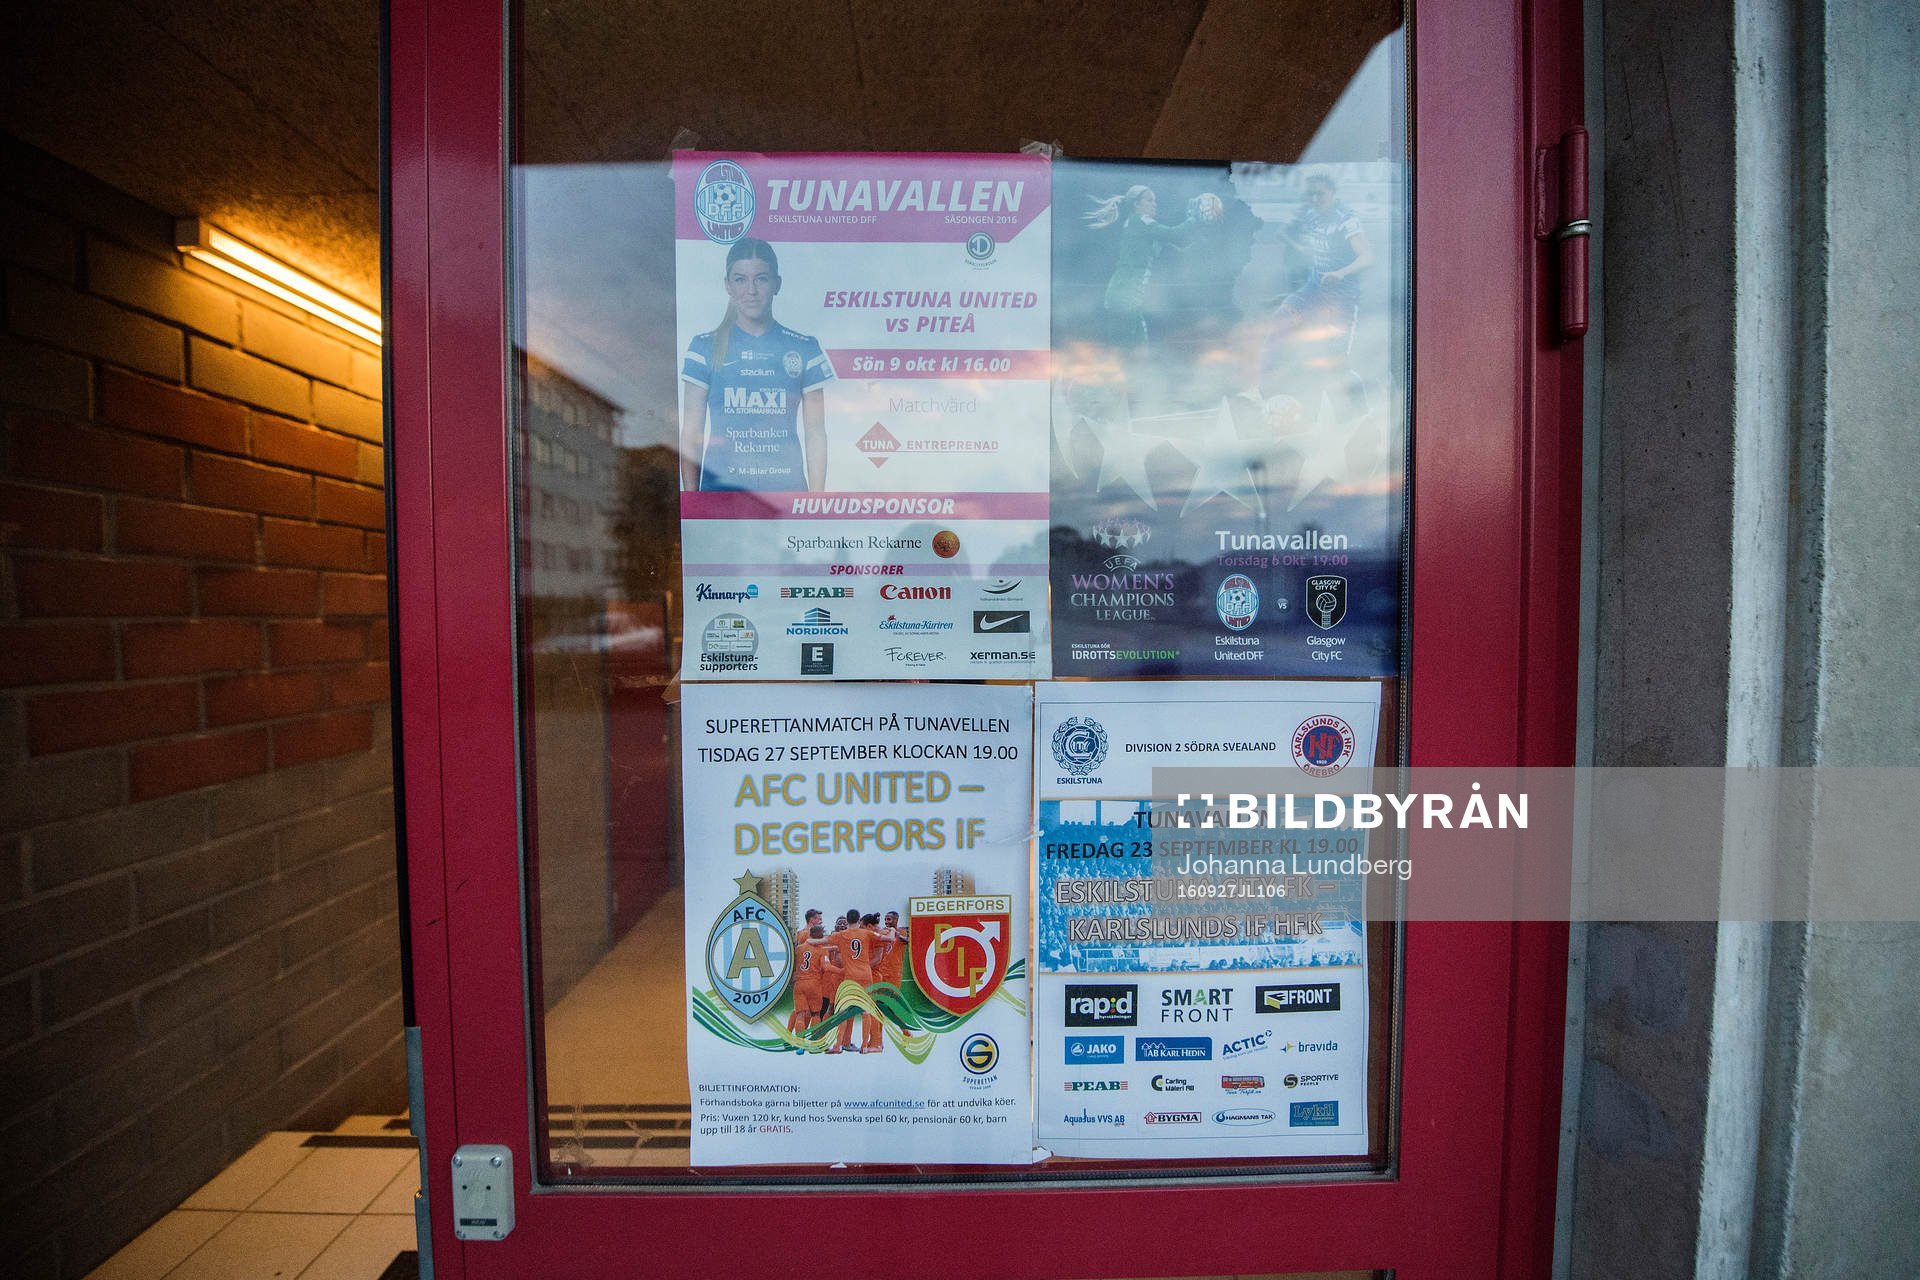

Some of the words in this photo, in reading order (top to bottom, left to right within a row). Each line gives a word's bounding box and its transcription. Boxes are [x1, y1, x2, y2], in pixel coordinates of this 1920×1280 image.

[766, 178, 1025, 213] TUNAVALLEN
[768, 214, 823, 224] ESKILSTUNA
[824, 215, 858, 224] UNITED
[860, 215, 877, 225] DFF
[996, 215, 1019, 225] 2016
[823, 290, 952, 309] ESKILSTUNA
[959, 291, 1039, 309] UNITED
[915, 313, 976, 333] PITEÅ
[852, 356, 885, 373] Sön
[889, 356, 901, 373] 9
[904, 356, 936, 373] okt
[940, 357, 958, 373] kl
[964, 356, 1012, 373] 16.00
[739, 368, 775, 377] stadium
[723, 387, 787, 408] MAXI
[888, 397, 977, 414] Matchvärd
[726, 427, 788, 442] Sparbanken
[734, 441, 781, 454] Rekarne
[862, 439, 895, 450] TUNA
[906, 440, 999, 451] ENTREPRENAD
[791, 497, 956, 516] HUVUDSPONSOR
[786, 534, 864, 553] Sparbanken
[867, 535, 922, 550] Rekarne
[1214, 529, 1349, 551] Tunavallen
[1104, 557, 1138, 570] UEFA
[1216, 554, 1269, 569] Torsdag
[1282, 554, 1305, 567] Okt
[1312, 554, 1349, 567] 19:00
[829, 564, 905, 576] SPONSORER
[1071, 573, 1175, 591] WOMEN'S
[696, 582, 751, 603] Kinnarps
[788, 587, 846, 598] PEAB
[879, 584, 952, 601] Canon
[1070, 592, 1175, 607] CHAMPIONS
[1096, 609, 1151, 621] LEAGUE
[786, 627, 849, 635] NORDIKON
[879, 619, 954, 631] Eskilstuna-Kuriren
[1215, 635, 1260, 646] Eskilstuna
[1306, 635, 1346, 648] Glasgow
[811, 646, 824, 662] E
[1214, 650, 1246, 661] United
[1246, 650, 1265, 661] DFF
[1311, 650, 1329, 663] City
[1330, 650, 1343, 661] FC
[699, 662, 759, 673] supporters
[705, 716, 874, 735] SUPERETTANMATCH
[878, 712, 901, 732] PÅ
[904, 716, 1010, 733] TUNAVELLEN
[1294, 718, 1340, 758] KARLSLUNDS
[1341, 736, 1352, 758] HFK
[697, 747, 760, 763] TISDAG
[764, 746, 785, 762] 27
[789, 745, 888, 762] SEPTEMBER
[892, 744, 968, 761] KLOCKAN
[973, 746, 1019, 761] 19.00
[1125, 742, 1173, 753] DIVISION
[1174, 742, 1182, 752] 2
[1184, 739, 1221, 752] SÖDRA
[1222, 741, 1277, 752] SVEALAND
[1302, 762, 1341, 777] ÖREBRO
[1056, 777, 1103, 785] ESKILSTUNA
[735, 774, 807, 808] AFC
[817, 770, 951, 806] UNITED
[734, 819, 945, 856] DEGERFORS
[956, 818, 985, 850] IF
[1045, 842, 1125, 860] FREDAG
[1129, 841, 1153, 858] 23
[1159, 839, 1274, 857] SEPTEMBER
[1279, 838, 1300, 855] KL
[1307, 837, 1359, 855] 19.00
[1283, 875, 1314, 898] FK
[916, 899, 1005, 913] DEGERFORS
[733, 906, 766, 922] AFC
[1069, 914, 1238, 942] KARLSLUNDS
[1245, 913, 1267, 938] IF
[1273, 911, 1324, 937] HFK
[726, 927, 775, 979] A
[851, 938, 862, 960] 9
[800, 951, 812, 970] 3
[733, 991, 769, 1005] 2007
[1161, 987, 1234, 1007] SMART
[1287, 988, 1333, 1005] FRONT
[1161, 1008, 1234, 1023] FRONT
[1086, 1043, 1117, 1054] JAKO
[1222, 1033, 1266, 1056] ACTIC
[1298, 1040, 1339, 1053] bravida
[1147, 1049, 1159, 1057] AB
[1300, 1073, 1339, 1082] SPORTIVE
[698, 1084, 801, 1093] BILJETTINFORMATION:
[1071, 1080, 1122, 1091] PEAB
[700, 1098, 763, 1107] Förhandsboka
[765, 1099, 791, 1109] gärna
[792, 1099, 828, 1109] biljetter
[830, 1099, 842, 1110] på
[844, 1099, 926, 1109] www.afcunited.se
[927, 1099, 940, 1108] för
[942, 1099, 956, 1108] att
[957, 1098, 993, 1108] undvika
[994, 1097, 1017, 1107] köer.
[700, 1113, 720, 1122] Pris:
[722, 1114, 750, 1122] Vuxen
[752, 1113, 769, 1122] 120
[770, 1113, 782, 1124] kr,
[784, 1114, 807, 1123] kund
[808, 1114, 825, 1123] hos
[827, 1114, 863, 1123] Svenska
[864, 1114, 884, 1124] spel
[885, 1115, 898, 1124] 60
[899, 1115, 911, 1125] kr,
[912, 1115, 957, 1125] pensionär
[959, 1116, 972, 1124] 60
[973, 1116, 984, 1126] kr,
[986, 1115, 1008, 1124] barn
[1097, 1114, 1113, 1123] VVS
[1114, 1114, 1126, 1123] AB
[1158, 1113, 1199, 1123] BYGMA
[700, 1126, 718, 1136] upp
[720, 1125, 732, 1134] till
[734, 1125, 746, 1134] 18
[747, 1124, 758, 1134] år
[759, 1125, 795, 1134] GRATIS.
